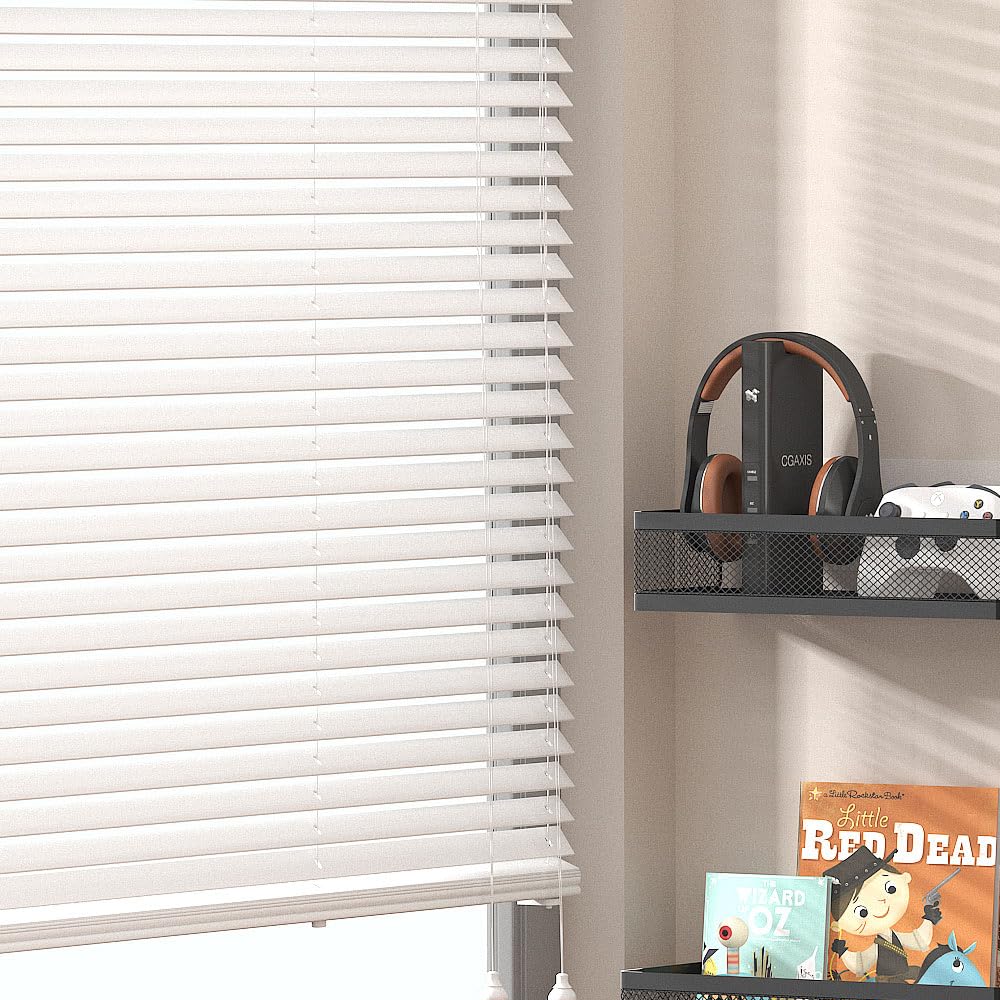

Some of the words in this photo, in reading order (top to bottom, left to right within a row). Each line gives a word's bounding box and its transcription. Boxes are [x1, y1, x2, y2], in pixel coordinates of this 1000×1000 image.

[781, 454, 812, 467] CGAXIS
[837, 803, 889, 830] Little
[801, 818, 886, 862] RED
[893, 822, 998, 867] DEAD
[736, 887, 806, 907] WIZARD
[749, 906, 792, 937] OZ
